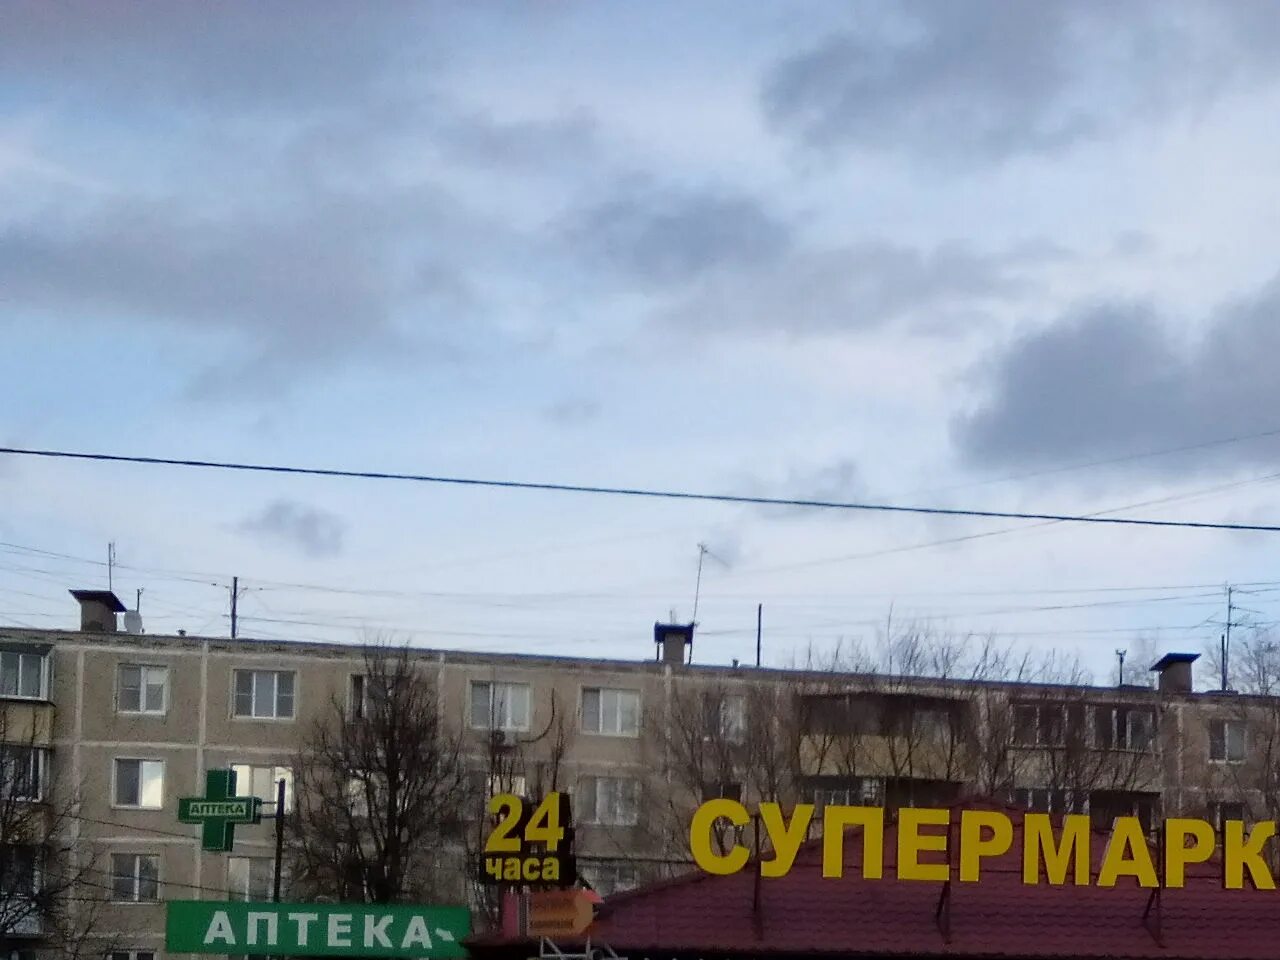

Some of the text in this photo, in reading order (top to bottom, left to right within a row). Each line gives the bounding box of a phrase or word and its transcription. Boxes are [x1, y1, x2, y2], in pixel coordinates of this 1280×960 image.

[190, 803, 245, 815] АПТЕКА
[484, 790, 564, 852] 24
[484, 856, 559, 882] часа
[203, 910, 433, 950] АПТЕКА
